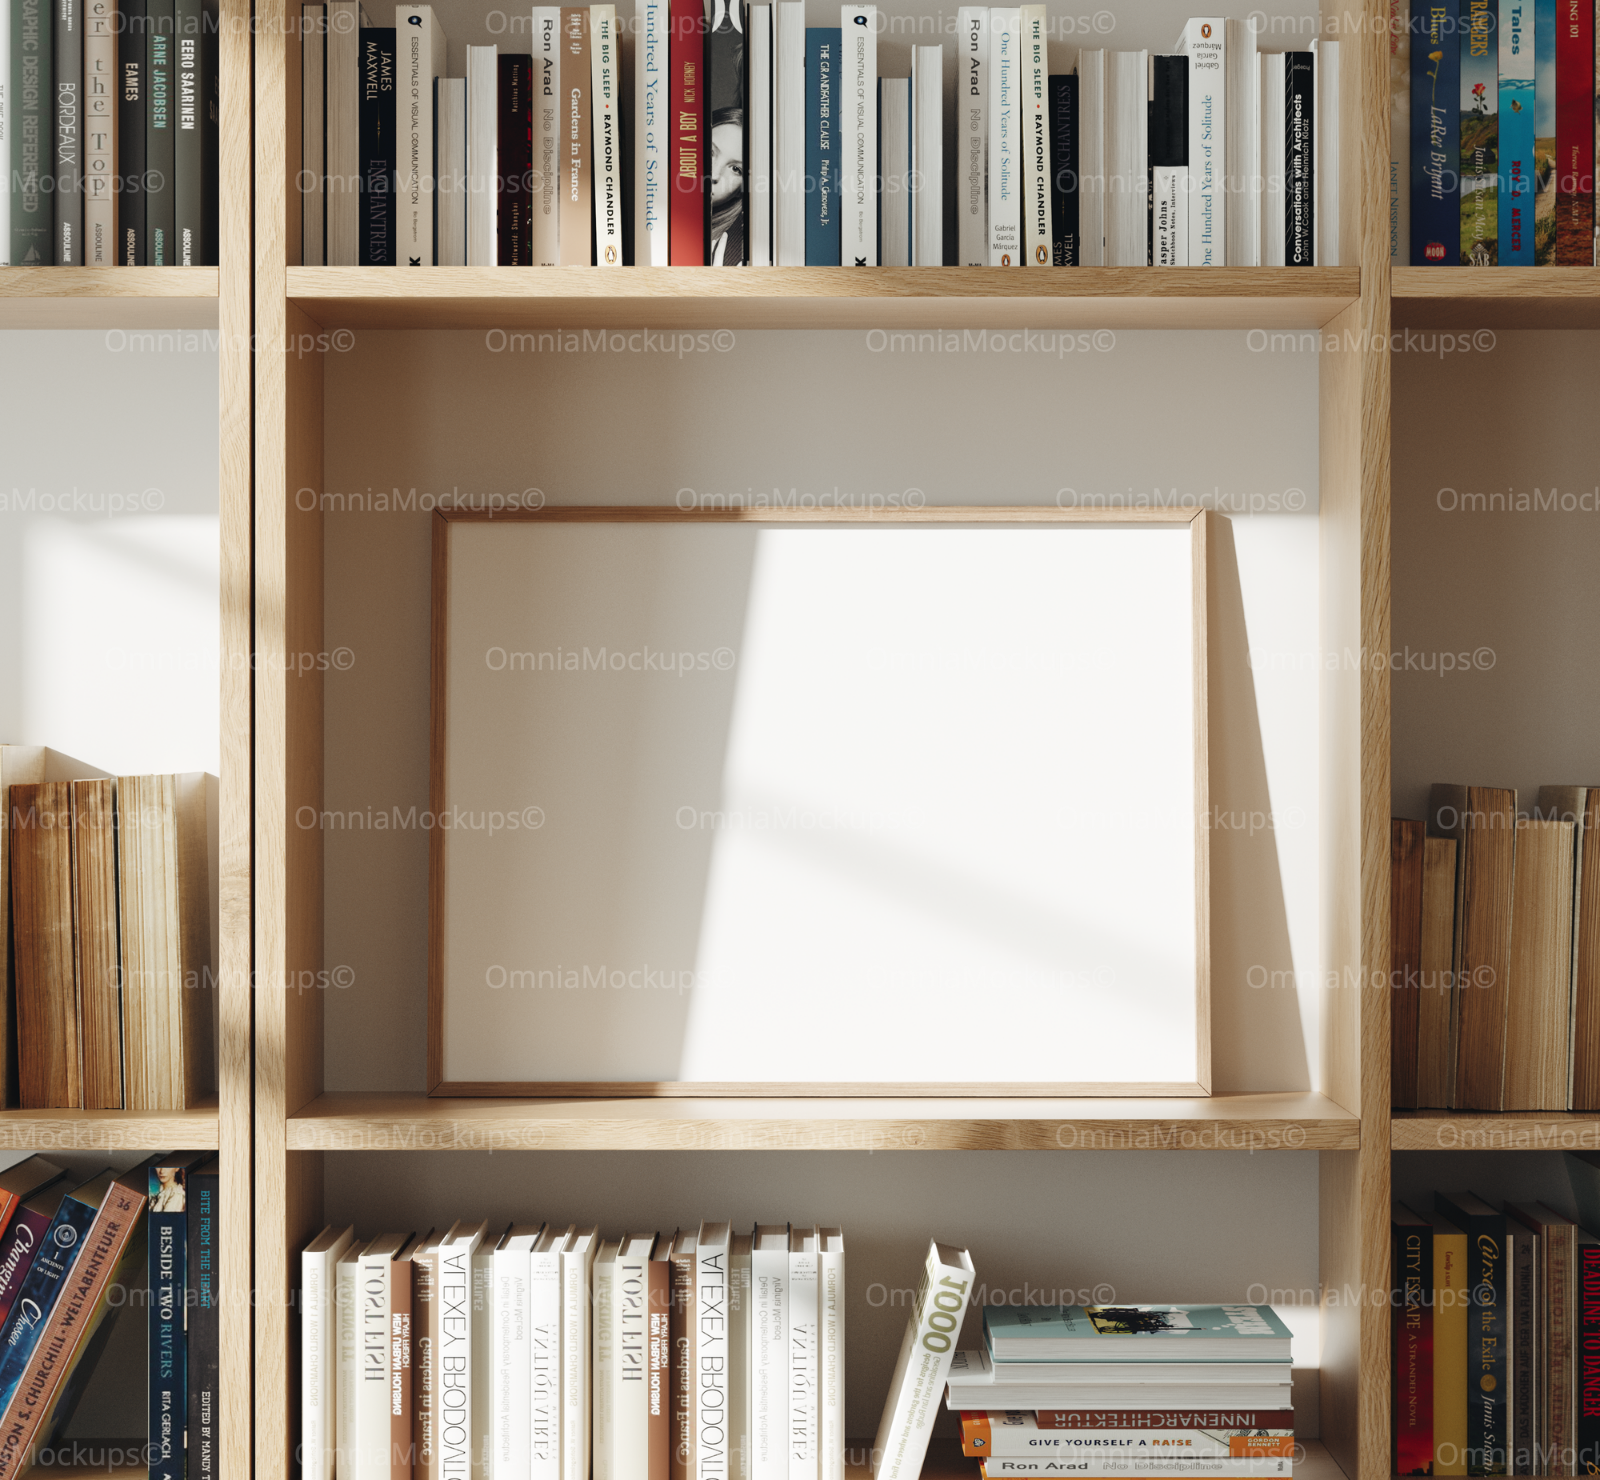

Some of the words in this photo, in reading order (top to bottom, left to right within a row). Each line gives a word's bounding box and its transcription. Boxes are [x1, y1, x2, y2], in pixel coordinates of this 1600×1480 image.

[543, 19, 554, 52] Ron
[601, 20, 609, 40] THE
[1430, 6, 1447, 45] Blues
[1511, 6, 1522, 56] Tales
[1570, 24, 1579, 39] 101
[153, 35, 166, 65] ARNE
[181, 39, 194, 68] EERO
[602, 44, 610, 64] BIG
[820, 44, 830, 62] THE
[1001, 32, 1010, 55] One
[366, 41, 378, 101] MAXWELL
[380, 50, 392, 92] JAMES
[411, 36, 419, 87] ESSENTIALS
[543, 58, 554, 96] Arad
[684, 61, 695, 86] HORNBY
[23, 56, 38, 110] DESIGN
[125, 63, 139, 101] EAMES
[153, 69, 166, 129] JACOBSEN
[411, 88, 419, 100] OF
[602, 68, 610, 99] SLEEP
[684, 87, 695, 103] NICK
[820, 63, 830, 119] GRANDFATHER
[1001, 59, 1011, 106] Hundred
[181, 72, 194, 130] SAARINEN
[411, 101, 419, 130] VISUAL
[571, 88, 582, 140] Gardens
[646, 78, 659, 126] Years
[58, 82, 76, 164] BORDEAUX
[543, 108, 554, 131] No
[680, 111, 697, 131] BOY
[820, 120, 830, 151] CLAUSE
[1001, 109, 1011, 139] Years
[1293, 94, 1302, 151] Architects
[1430, 105, 1447, 148] LaRee
[571, 142, 581, 155] in
[604, 114, 613, 172] RAYMOND
[646, 132, 659, 153] of
[680, 134, 697, 142] A
[1001, 141, 1011, 155] of
[23, 115, 38, 213] REFERENCED
[411, 132, 419, 205] COMMUNICATION
[543, 137, 554, 215] Discipline
[680, 147, 697, 179] ABOUT
[821, 159, 830, 177] Philip
[1293, 154, 1302, 178] with
[1423, 150, 1447, 199] Bryant
[1473, 144, 1486, 175] Janis
[1511, 160, 1521, 184] ROY
[571, 158, 582, 201] France
[646, 159, 658, 231] Solitude
[1001, 157, 1011, 201] Solitude
[370, 159, 387, 262] ENCHANTRESS
[605, 176, 615, 236] CHANDLER
[1159, 200, 1168, 226] Johns
[1293, 181, 1302, 263] Conversations
[63, 222, 71, 262] ASSOULINE
[95, 223, 103, 262] ASSOULINE
[994, 224, 1016, 232] Gabriel
[996, 233, 1015, 241] García
[1472, 213, 1486, 240] May
[1511, 207, 1521, 252] MERCER
[126, 228, 136, 266] ASSOULINE
[182, 228, 191, 266] ASSOULINE
[992, 242, 1018, 251] Márquez
[1425, 247, 1444, 257] MOON
[117, 1198, 131, 1212] 36
[200, 1190, 211, 1214] BITE
[200, 1217, 211, 1245] FROM
[160, 1226, 173, 1280] BESIDE
[200, 1248, 211, 1270] THE
[1406, 1235, 1421, 1271] CITY
[160, 1285, 173, 1320] TWO
[200, 1273, 211, 1309] HEART
[1406, 1276, 1421, 1330] ESCAPE
[1482, 1291, 1497, 1308] of
[1583, 1249, 1600, 1326] DEADLINE
[25, 1335, 67, 1406] CHURCHILL
[60, 1221, 121, 1328] WELTABENTEUER
[1482, 1310, 1493, 1332] the
[160, 1324, 173, 1379] RIVERS
[1482, 1337, 1497, 1371] Exile
[1583, 1332, 1600, 1351] TO
[162, 1390, 171, 1411] RITA
[1583, 1355, 1600, 1418] DANGER
[202, 1391, 211, 1424] EDITED
[1481, 1394, 1496, 1429] Janis
[162, 1413, 171, 1459] GERLACH
[202, 1427, 211, 1438] BY
[202, 1441, 211, 1472] MANDY
[1002, 1462, 1038, 1470] Ron
[1045, 1462, 1088, 1470] Arad
